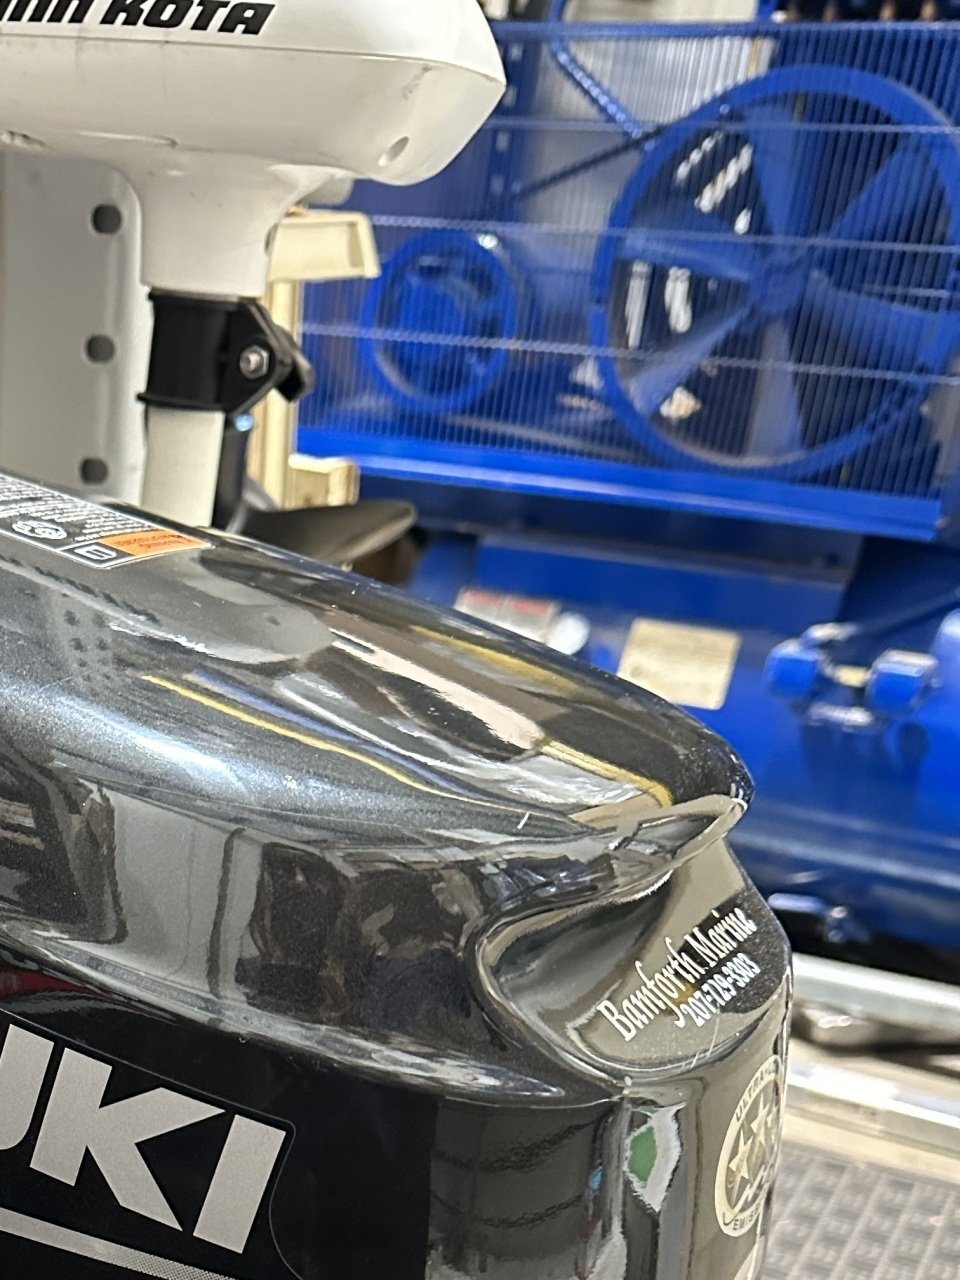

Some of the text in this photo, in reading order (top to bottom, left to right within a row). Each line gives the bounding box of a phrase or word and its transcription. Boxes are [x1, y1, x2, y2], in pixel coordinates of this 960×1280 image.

[99, 0, 276, 36] KOTA
[596, 909, 758, 1042] Bamforth Marine
